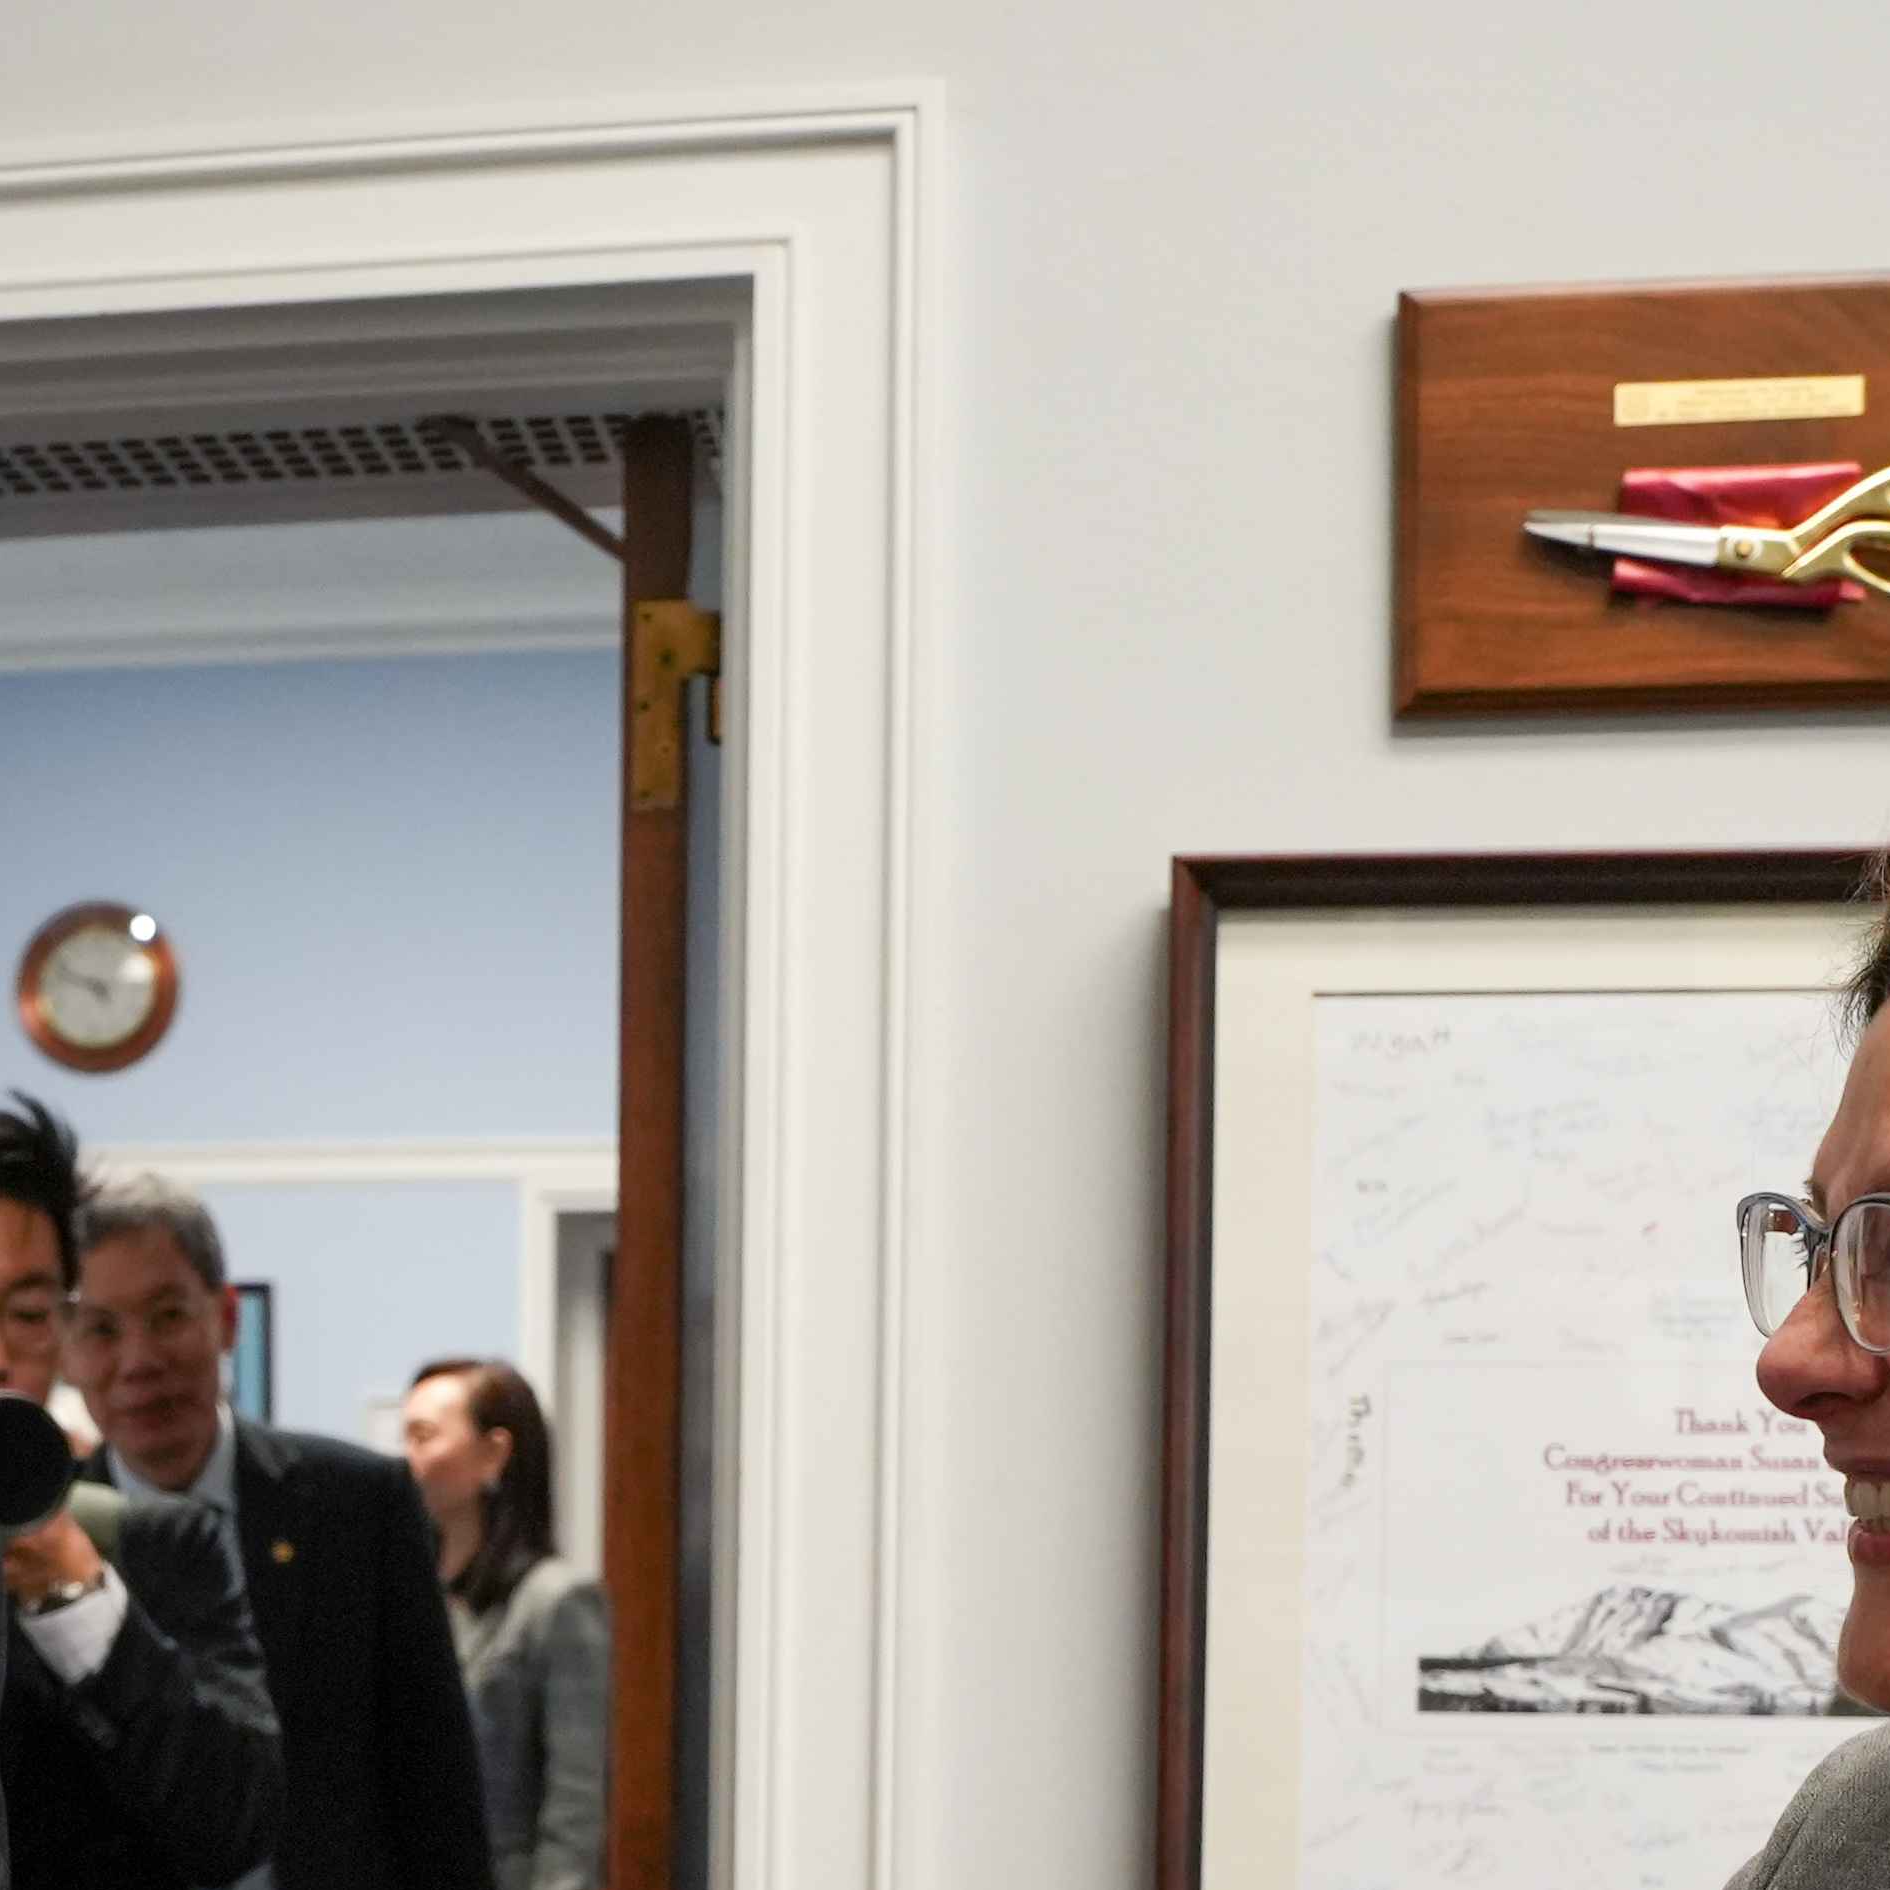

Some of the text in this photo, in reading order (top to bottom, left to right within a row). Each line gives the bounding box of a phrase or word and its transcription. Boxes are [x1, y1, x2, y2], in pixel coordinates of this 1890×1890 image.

[1675, 1408, 1808, 1434] Thank You
[1543, 1443, 1743, 1475] Congresswoman
[1565, 1481, 1602, 1506] For
[1611, 1481, 1671, 1506] Your
[1676, 1481, 1808, 1507] Continued
[1587, 1516, 1847, 1547] of the Skykomish Val
